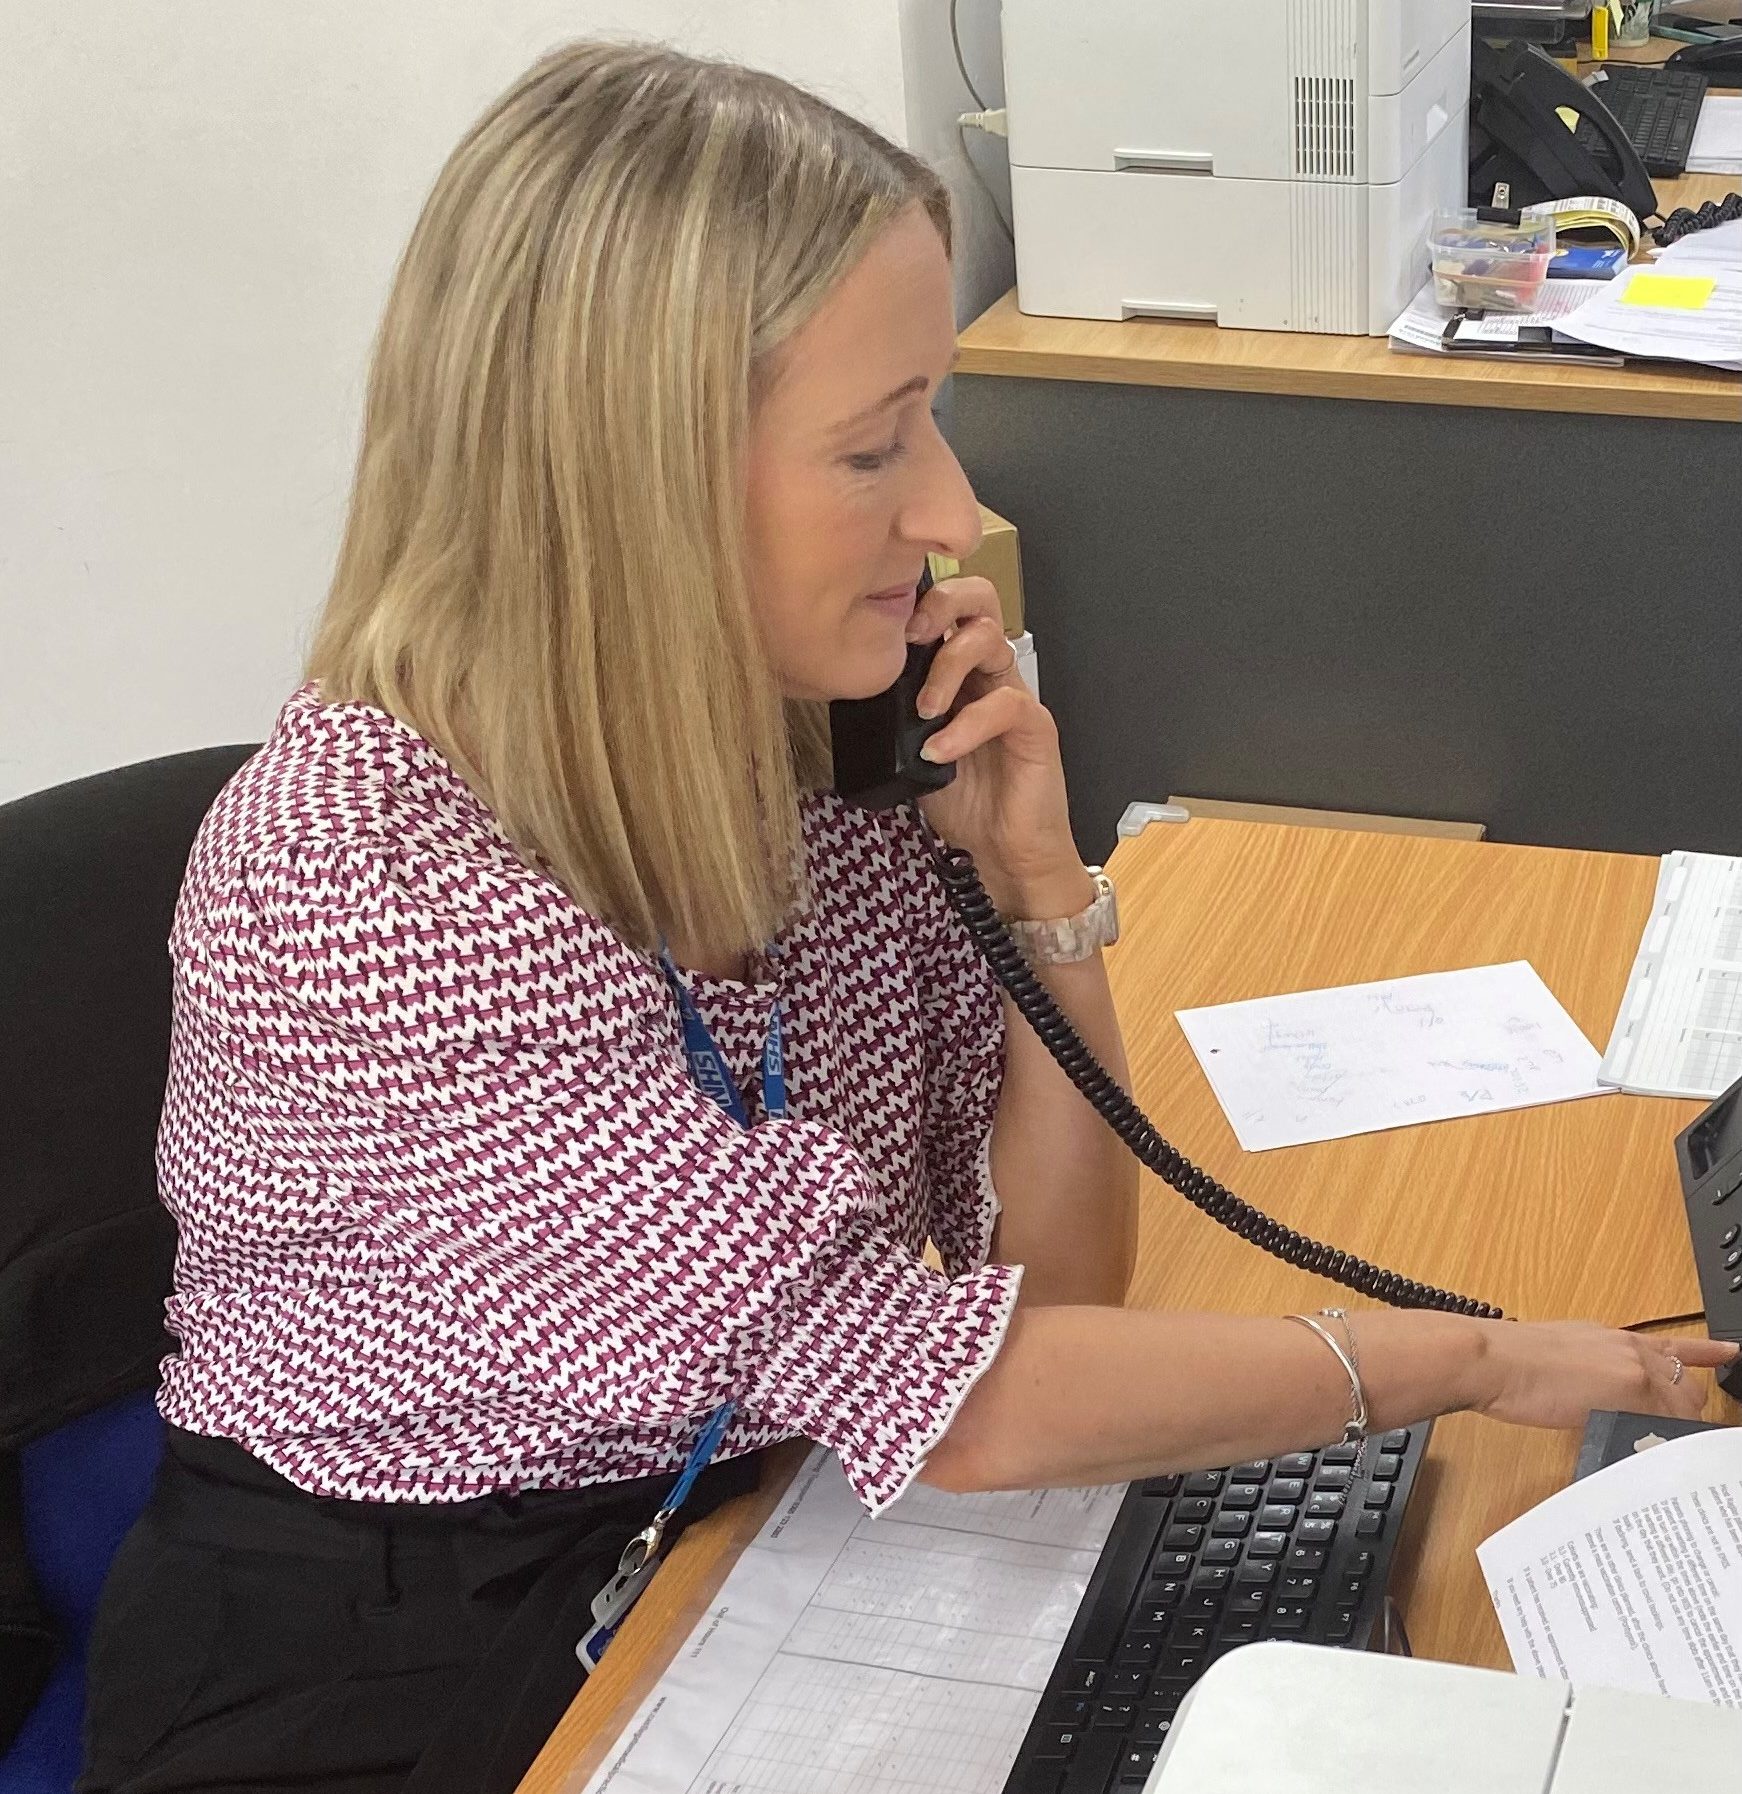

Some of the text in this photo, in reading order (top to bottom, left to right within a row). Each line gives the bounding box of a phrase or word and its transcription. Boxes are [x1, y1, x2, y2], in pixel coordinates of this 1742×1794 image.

[766, 1016, 781, 1073] NHS
[698, 1053, 731, 1107] NHS
[716, 1607, 729, 1619] Out
[698, 1627, 716, 1646] Hours
